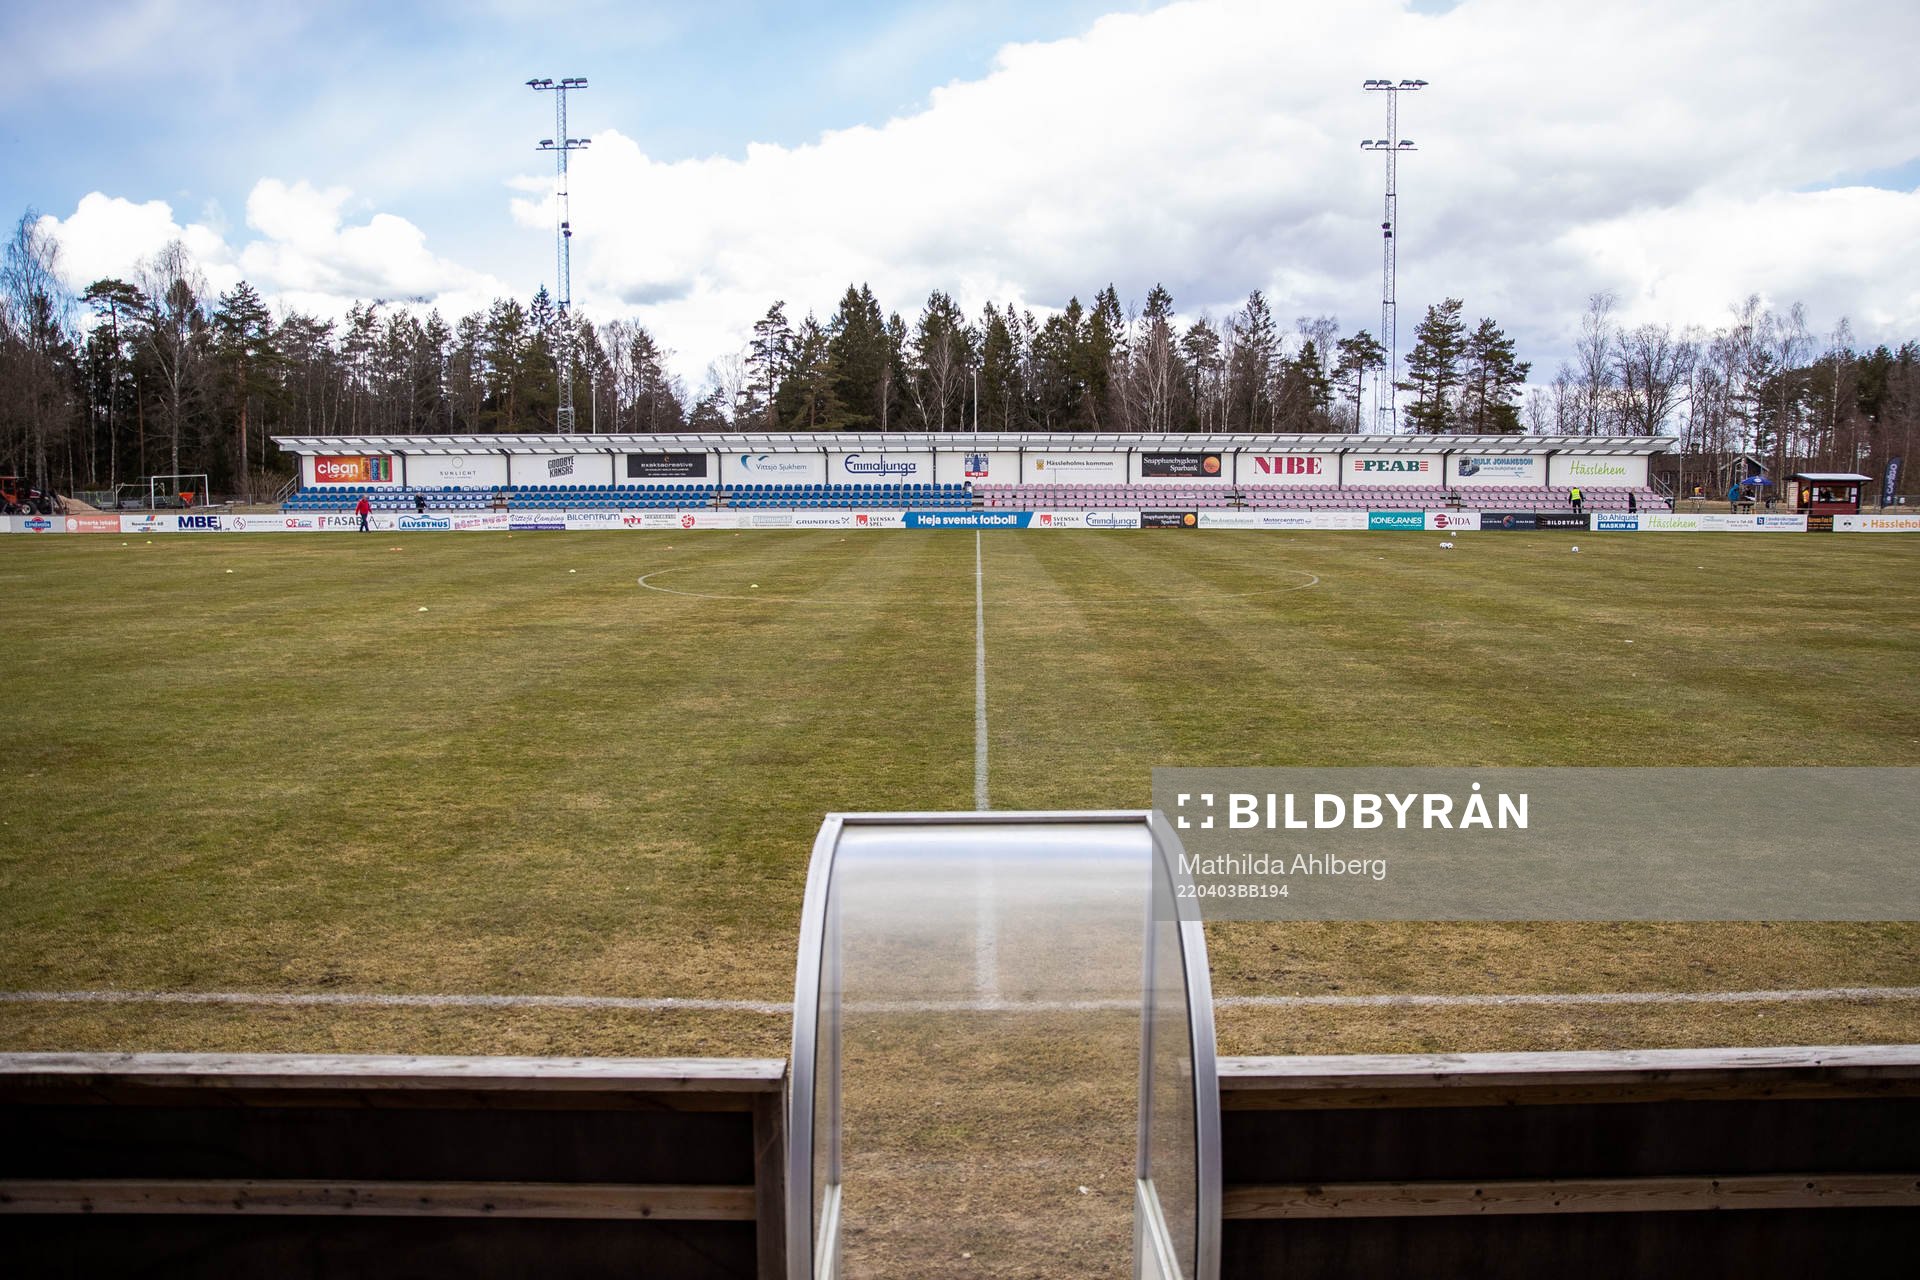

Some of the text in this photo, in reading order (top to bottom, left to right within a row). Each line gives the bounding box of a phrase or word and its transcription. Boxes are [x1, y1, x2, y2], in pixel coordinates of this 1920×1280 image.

[318, 461, 359, 474] clean
[547, 455, 575, 469] GOODBYE
[779, 463, 807, 472] Sjukhem
[845, 454, 917, 477] Emmaljunga
[1253, 456, 1322, 475] NIBE
[1363, 460, 1420, 472] PEAB
[1473, 458, 1492, 466] BULK
[1569, 460, 1626, 476] Hässlehem
[549, 465, 574, 478] KANSAS
[1170, 465, 1198, 473] Sparbank
[178, 516, 218, 528] MBE
[917, 514, 1018, 526] Heja svensk fotboll!
[1085, 512, 1138, 529] Emmaljunga
[1371, 516, 1422, 524] KONECRANES
[1447, 516, 1471, 526] VIDA
[1597, 513, 1639, 523] Bo Ahlquist
